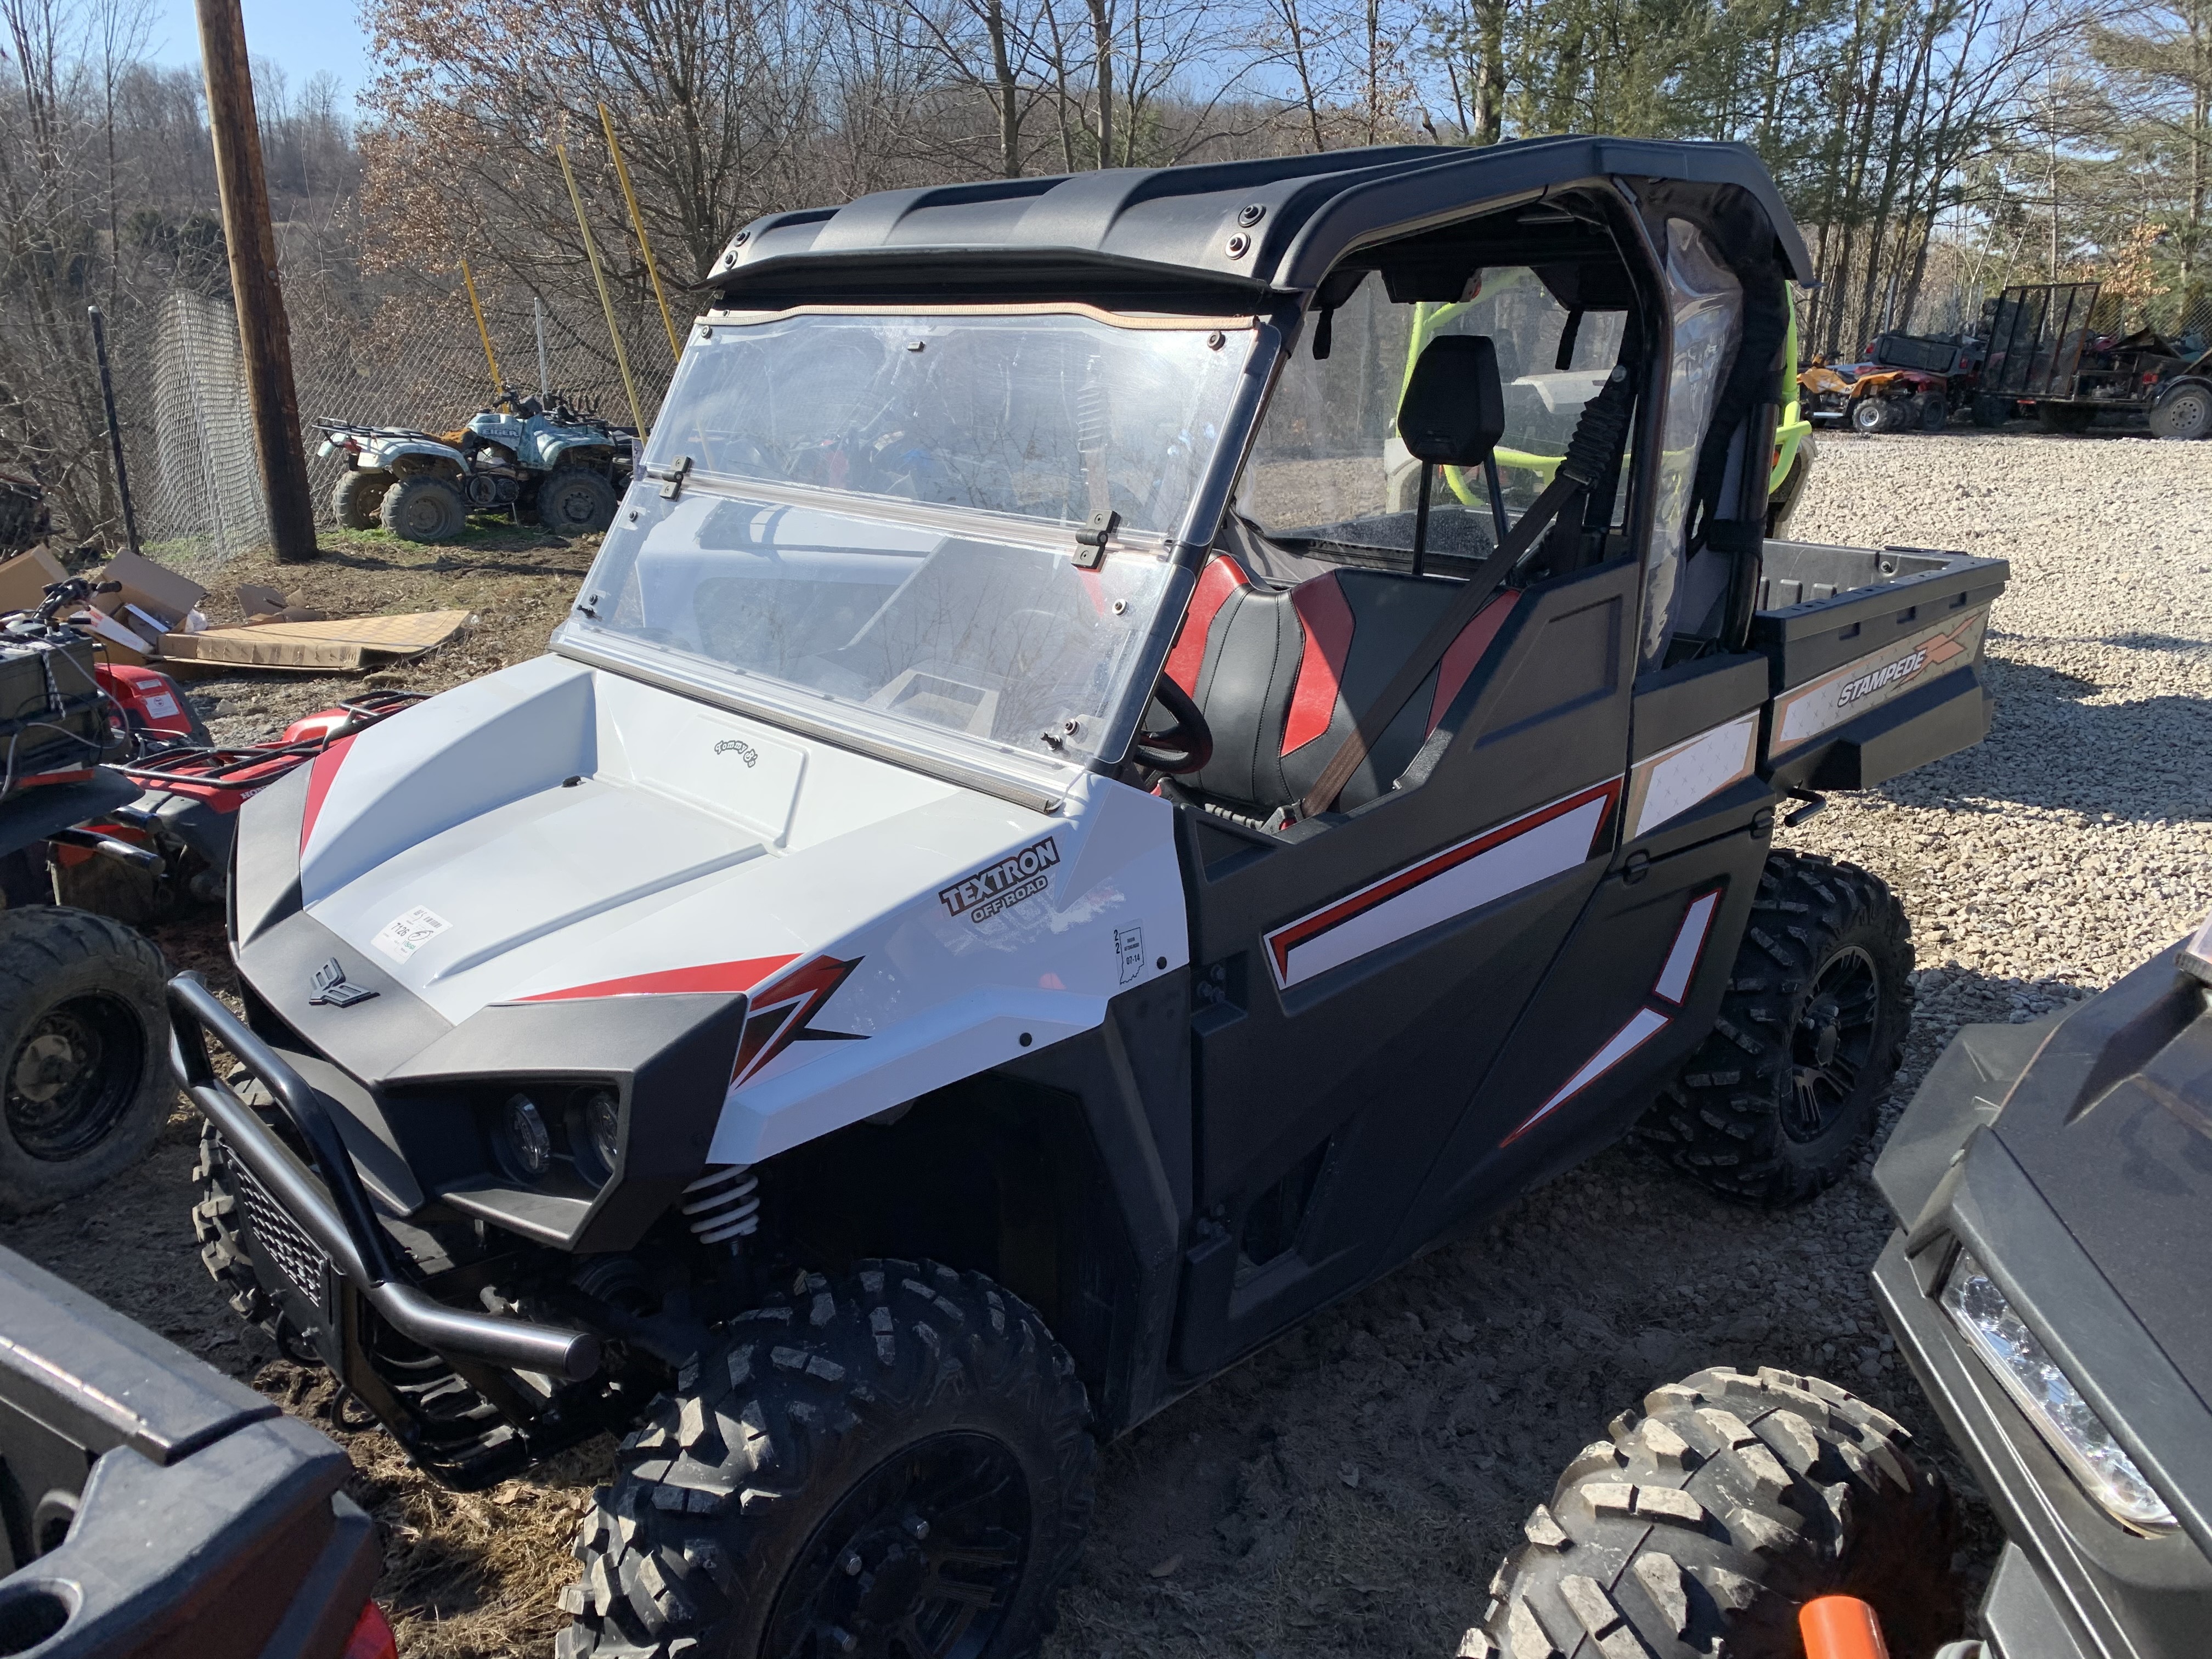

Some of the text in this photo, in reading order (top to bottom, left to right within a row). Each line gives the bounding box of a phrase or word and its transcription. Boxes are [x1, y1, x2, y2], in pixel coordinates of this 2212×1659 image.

[482, 428, 519, 437] EIGER
[1837, 649, 1927, 707] STAMPEDE
[714, 740, 748, 754] Tommy
[240, 785, 269, 799] HON
[940, 837, 1059, 915] TEXTRON
[972, 876, 1047, 923] OFF ROAD
[391, 922, 410, 936] 7126
[1126, 953, 1141, 965] 07-14
